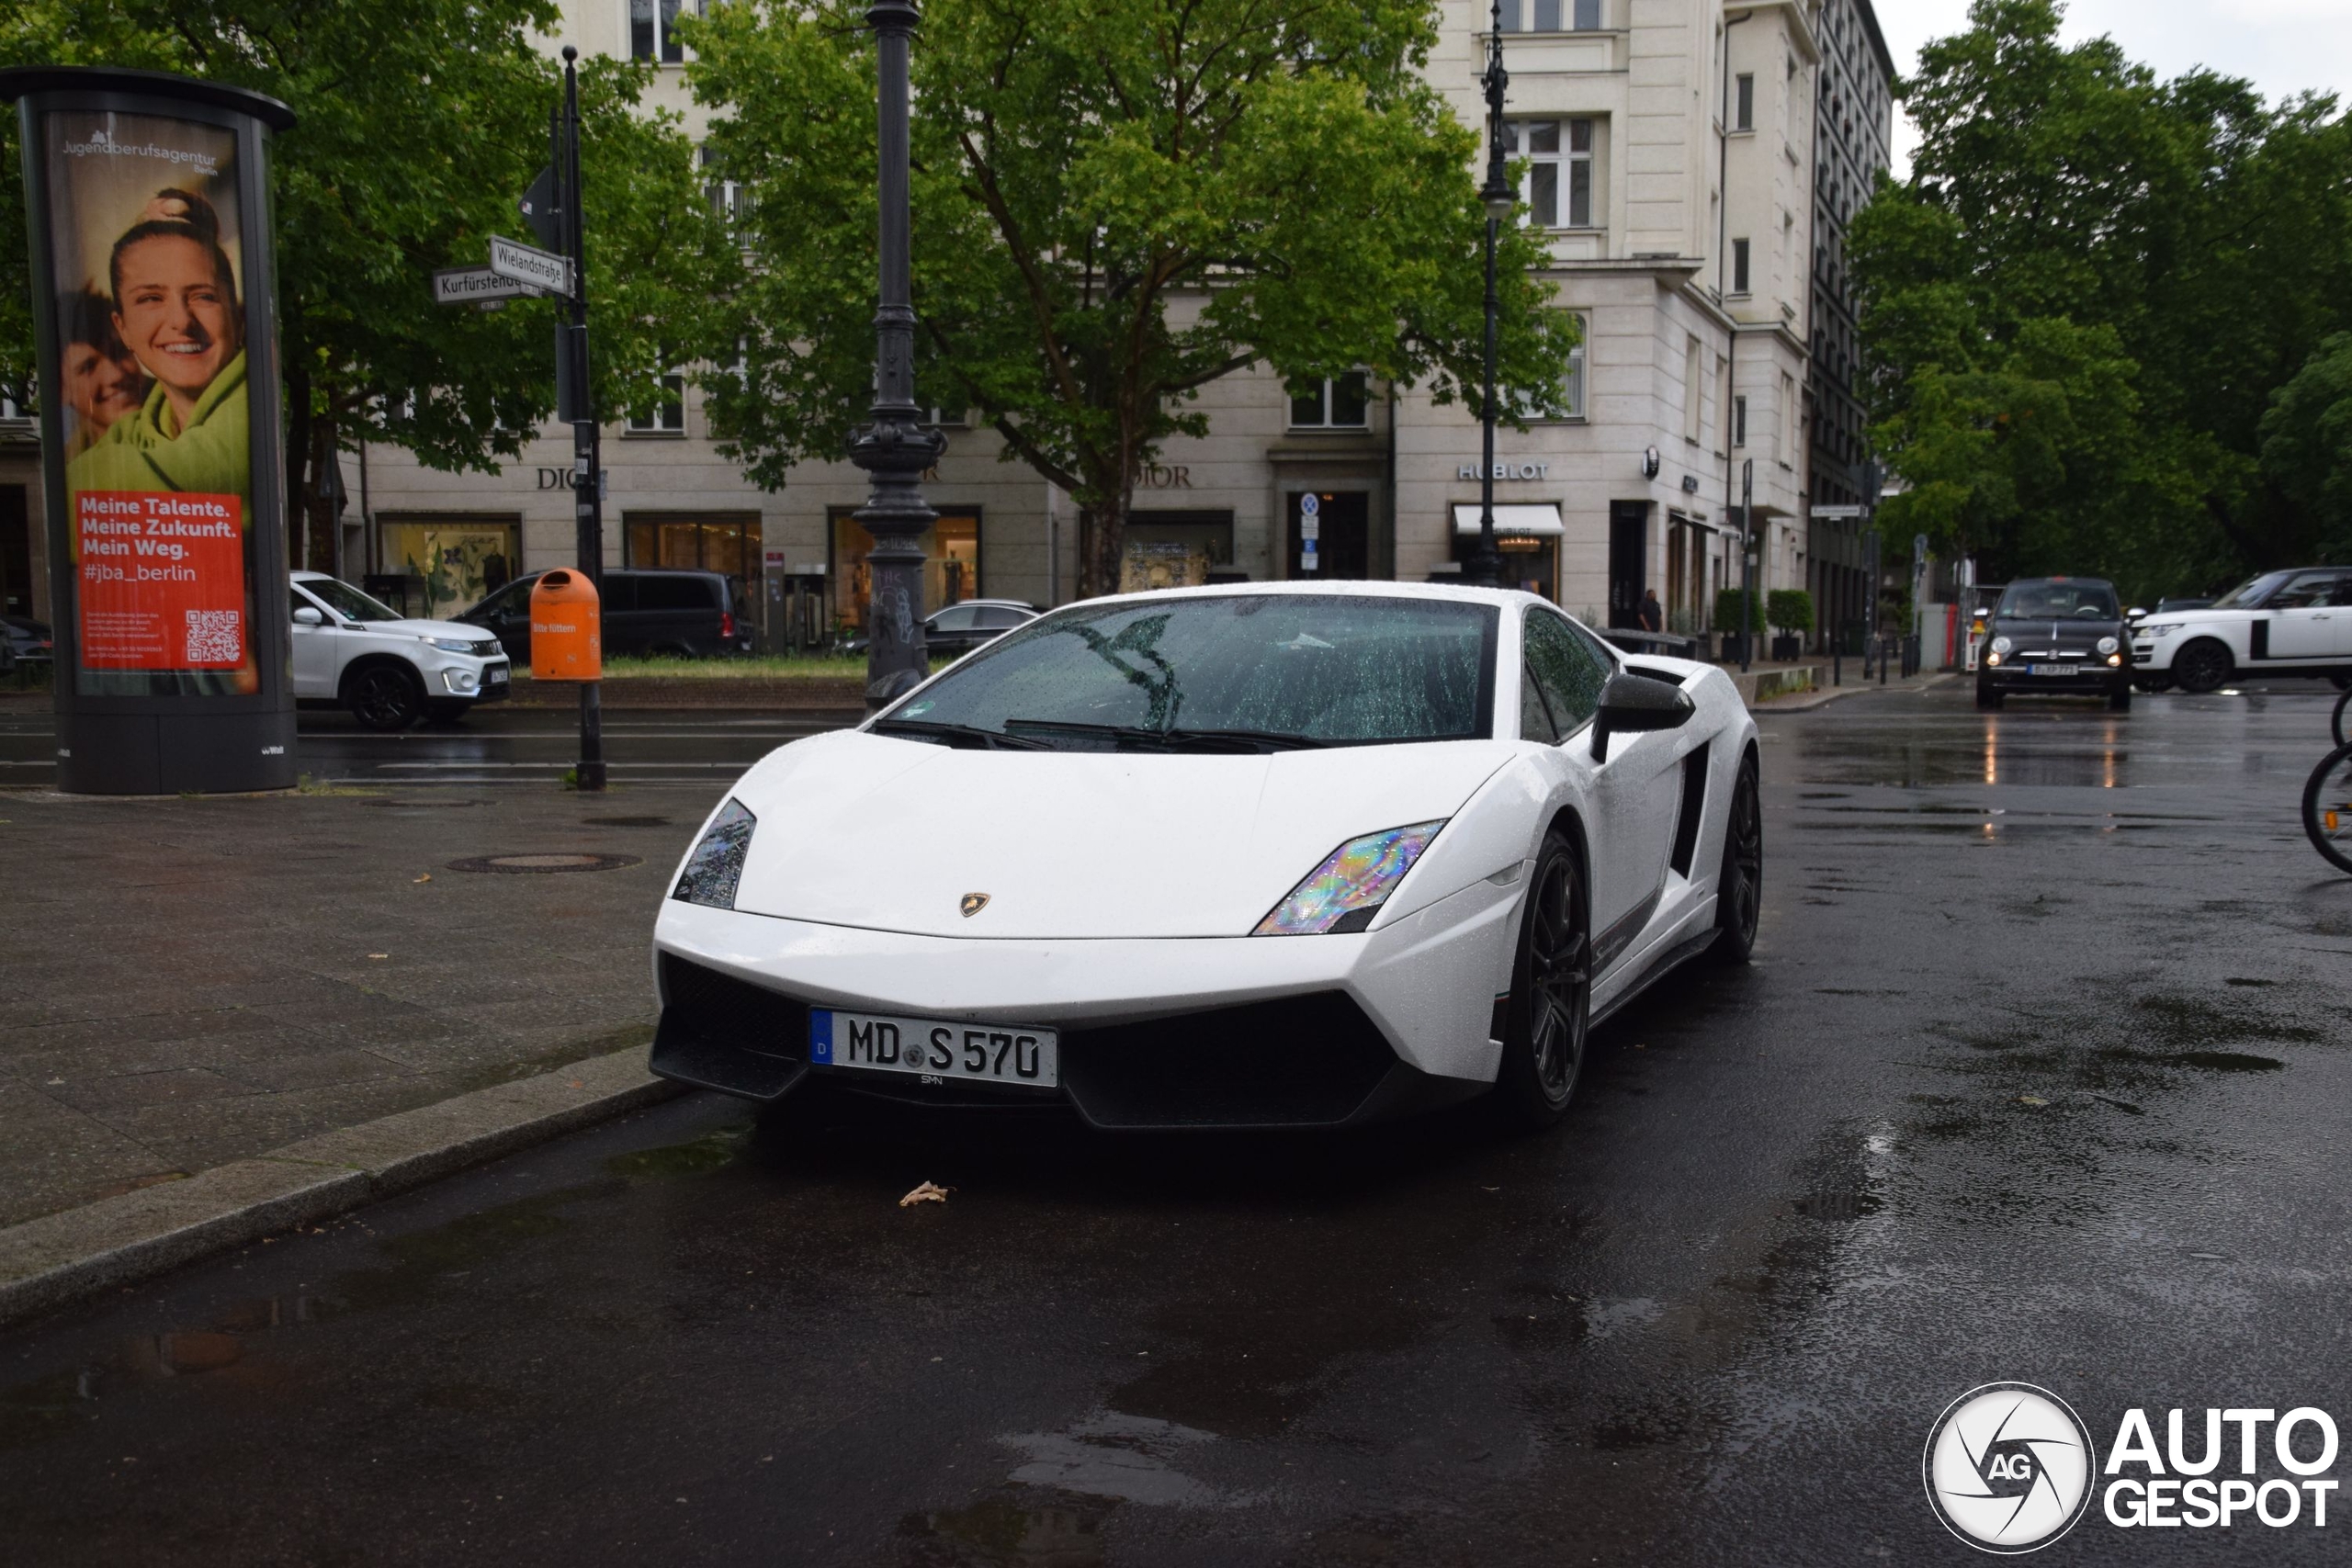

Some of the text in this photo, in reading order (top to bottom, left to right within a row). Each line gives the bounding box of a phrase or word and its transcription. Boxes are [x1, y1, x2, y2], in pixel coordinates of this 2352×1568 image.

[62, 141, 217, 165] Jugendberufsagentur
[193, 164, 218, 176] Berlin
[497, 244, 561, 283] Wielandstraße
[1136, 465, 1192, 489] IOR
[81, 497, 231, 518] Meine Talente.
[82, 518, 236, 538] Meine Zukunft.
[84, 539, 189, 560] Mein Weg.
[85, 564, 196, 583] #jba_berlin
[533, 623, 576, 634] Bitte füttern
[817, 1043, 826, 1055] D
[849, 1019, 1040, 1078] MD S 570
[921, 1074, 943, 1086] SMN
